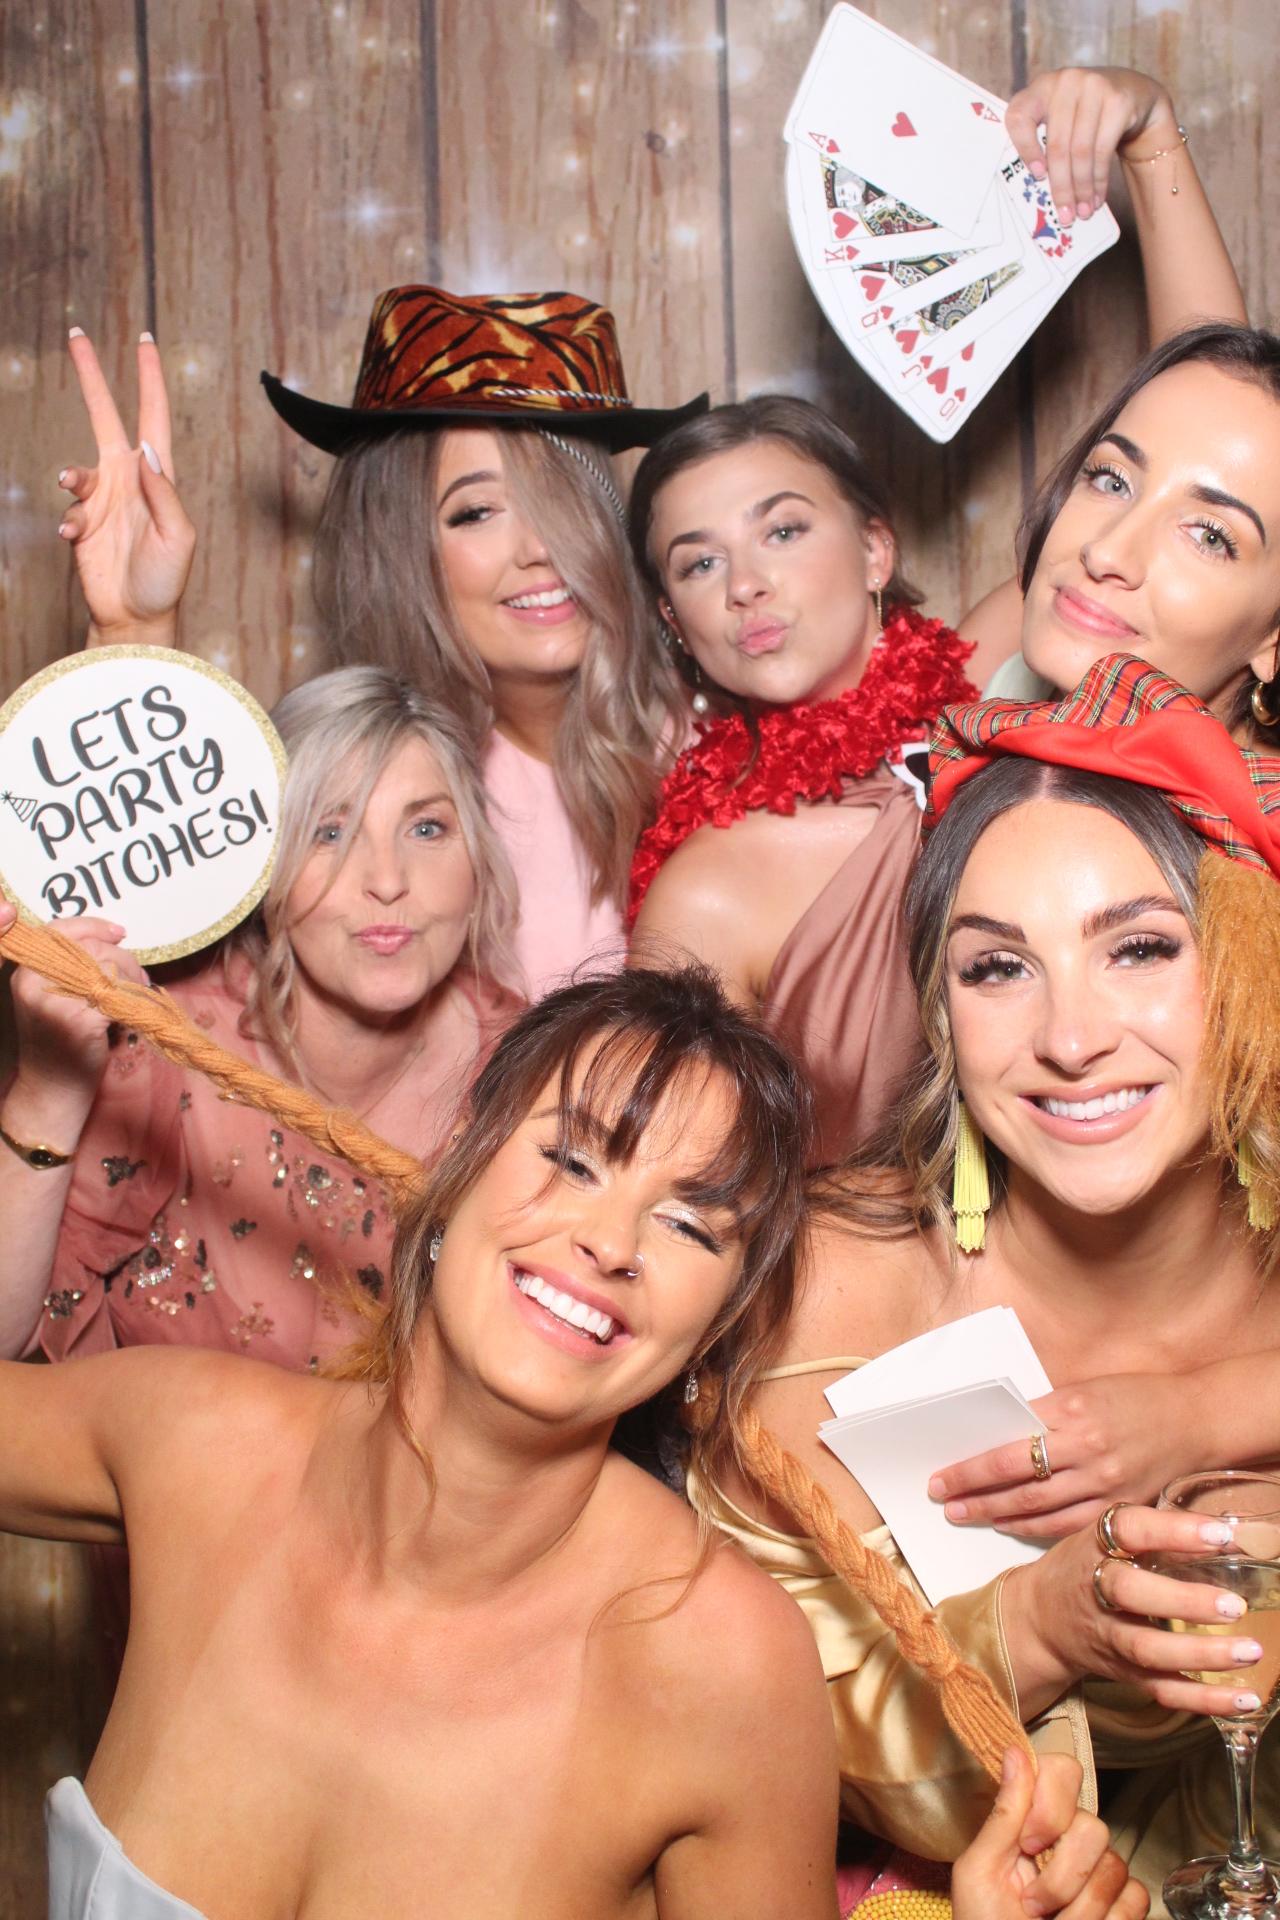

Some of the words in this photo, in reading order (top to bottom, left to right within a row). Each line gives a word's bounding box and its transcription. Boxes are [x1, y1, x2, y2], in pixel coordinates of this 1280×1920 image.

[984, 107, 1001, 123] A
[808, 132, 827, 148] A
[824, 245, 845, 263] K
[861, 309, 879, 328] Q
[902, 364, 922, 378] J
[940, 398, 959, 421] 10
[32, 685, 187, 787] LETS
[30, 738, 224, 860] PARTY
[41, 789, 272, 919] BITCHES!
